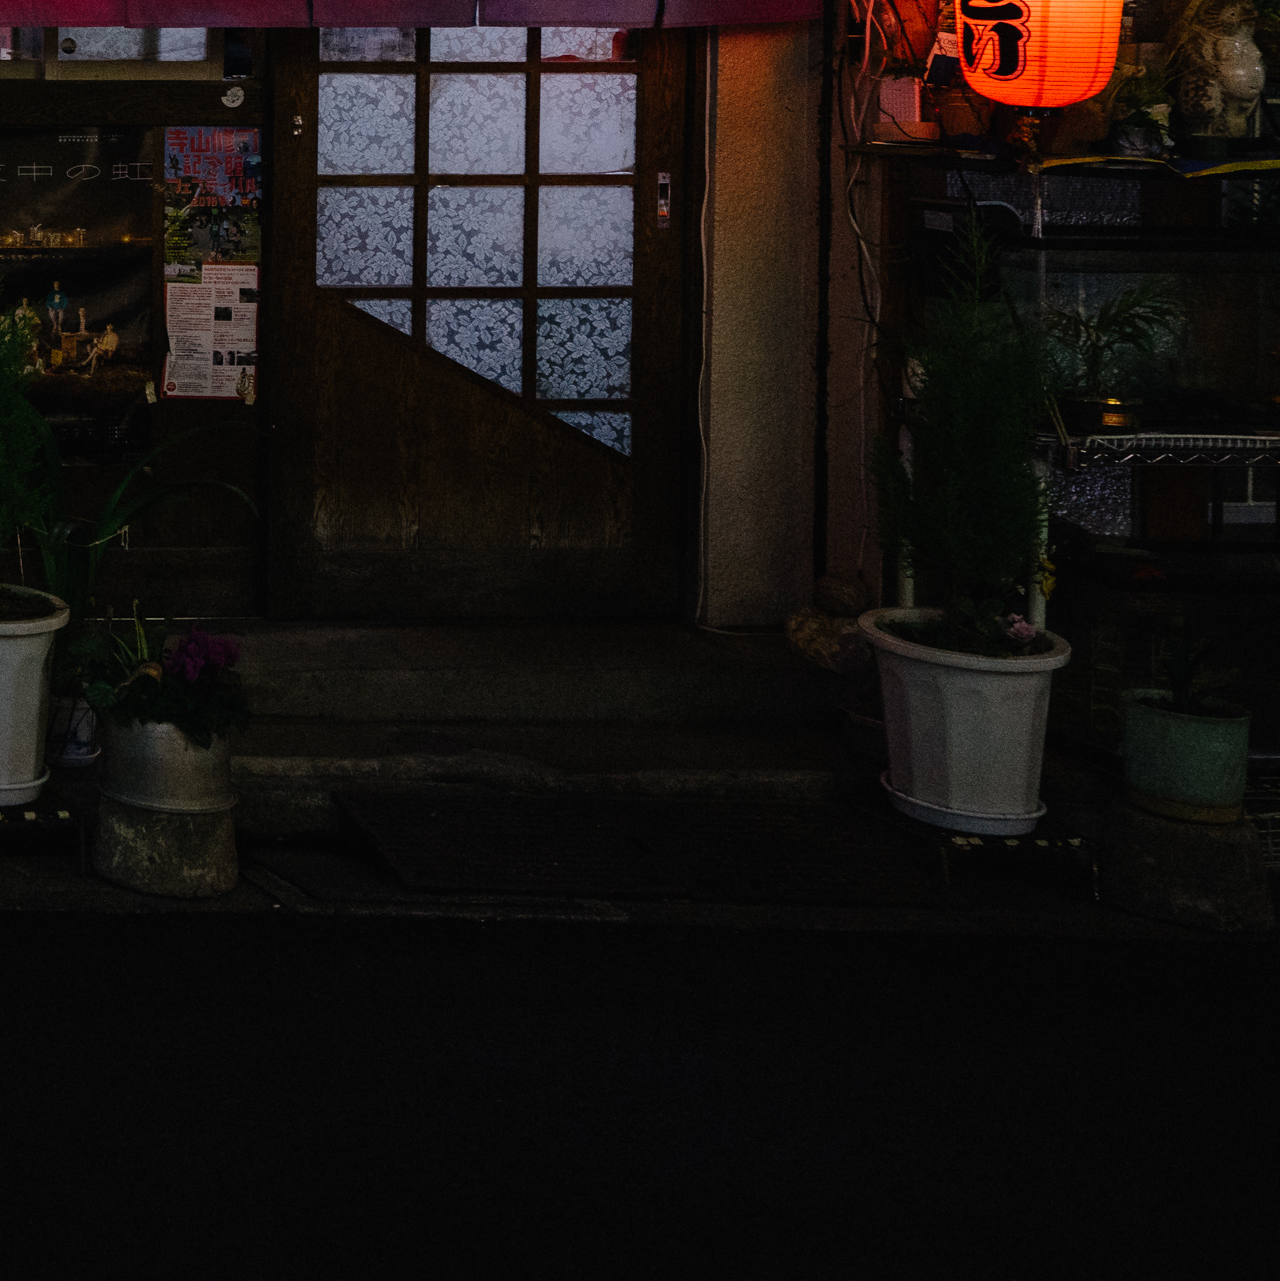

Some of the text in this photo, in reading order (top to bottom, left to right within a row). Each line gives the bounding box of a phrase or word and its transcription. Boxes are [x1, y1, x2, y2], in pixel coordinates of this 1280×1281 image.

[183, 155, 244, 177] 記念館
[166, 178, 260, 195] フェスティバル
